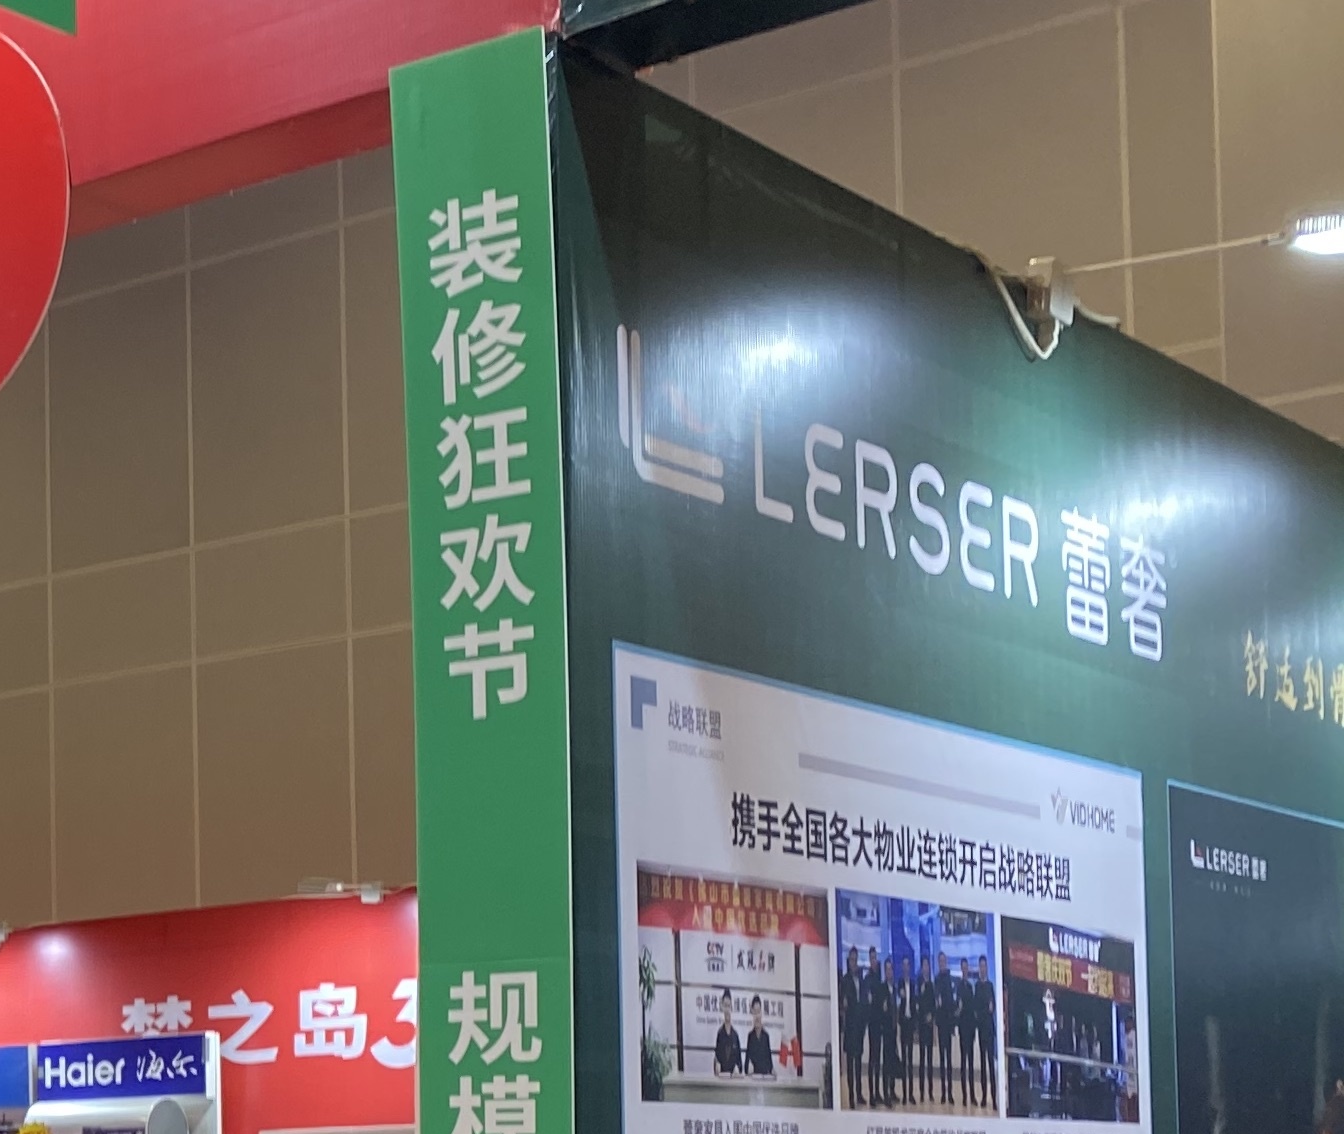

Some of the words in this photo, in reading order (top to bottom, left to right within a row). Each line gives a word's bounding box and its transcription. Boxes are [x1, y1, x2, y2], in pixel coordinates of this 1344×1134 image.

[427, 187, 535, 720] 装修狂欢节
[754, 407, 1042, 608] LERSER
[1060, 505, 1169, 664] 蕾奢
[667, 700, 722, 740] 战略联盟
[731, 791, 1072, 903] 携手全国各大物业连锁开启战略联盟
[1069, 801, 1116, 833] VIDHOME
[43, 1054, 125, 1089] Haier
